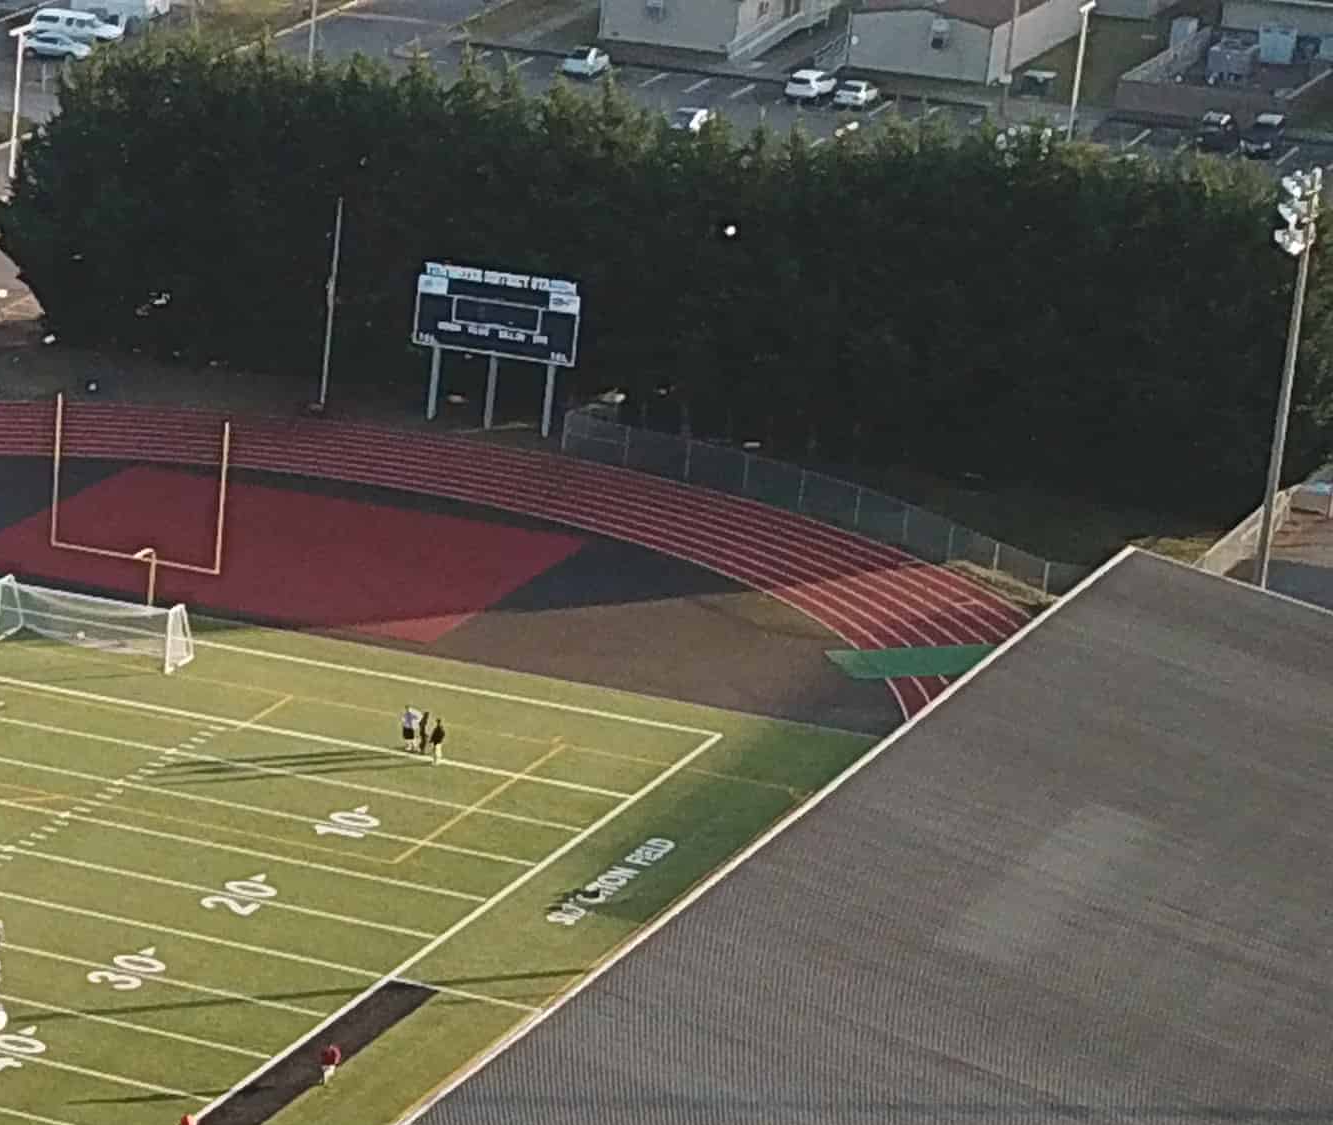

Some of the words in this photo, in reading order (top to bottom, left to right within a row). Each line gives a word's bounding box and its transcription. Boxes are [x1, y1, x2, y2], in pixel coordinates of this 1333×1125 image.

[315, 811, 380, 838] 10
[201, 881, 277, 915] 20
[87, 952, 166, 991] 30
